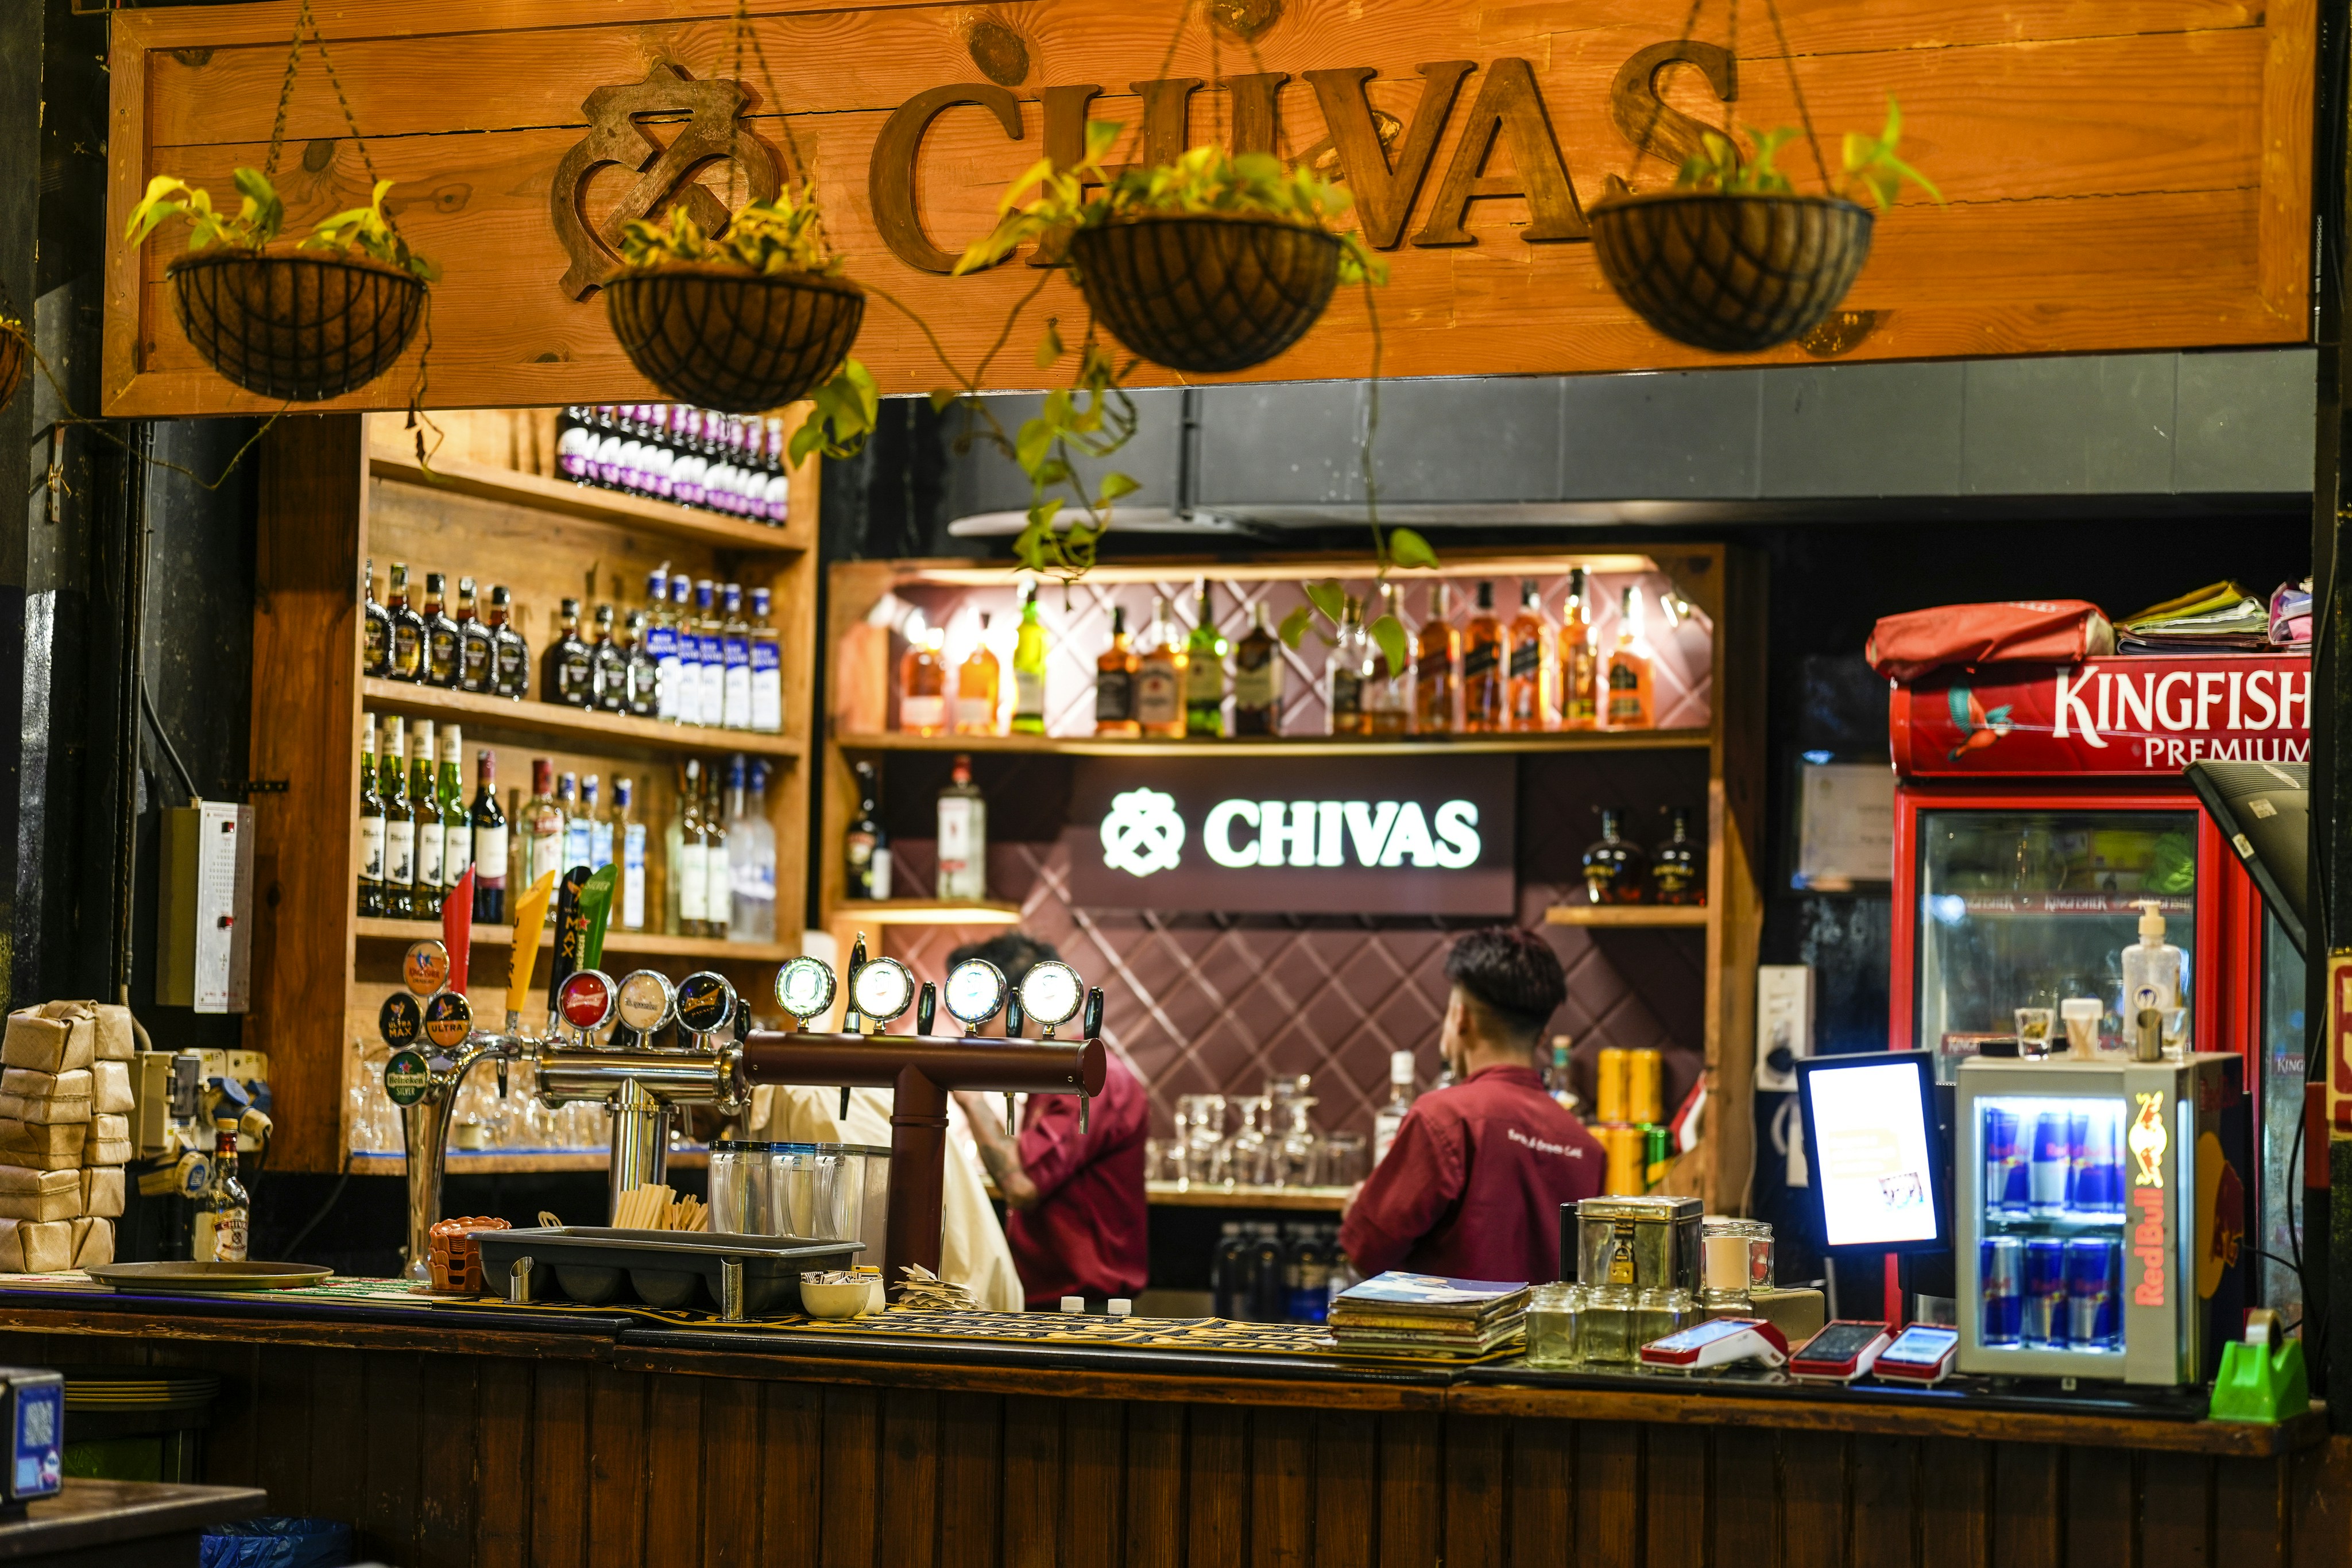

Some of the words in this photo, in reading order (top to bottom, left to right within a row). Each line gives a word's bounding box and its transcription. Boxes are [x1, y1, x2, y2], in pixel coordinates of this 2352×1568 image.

[1204, 799, 1481, 868] CHIVAS
[2045, 894, 2107, 912] KINGFISHER
[561, 916, 580, 958] MAX
[624, 997, 657, 1011] Hogaarden
[388, 1020, 412, 1028] ULTRA
[431, 1023, 463, 1033] ULTRA
[389, 1028, 412, 1037] MAX
[389, 1075, 423, 1085] Heineken
[396, 1087, 415, 1096] SILVER
[952, 1311, 1107, 1324] ULTRA
[917, 1319, 1070, 1331] ULTRA
[872, 1325, 1033, 1338] ULTRA
